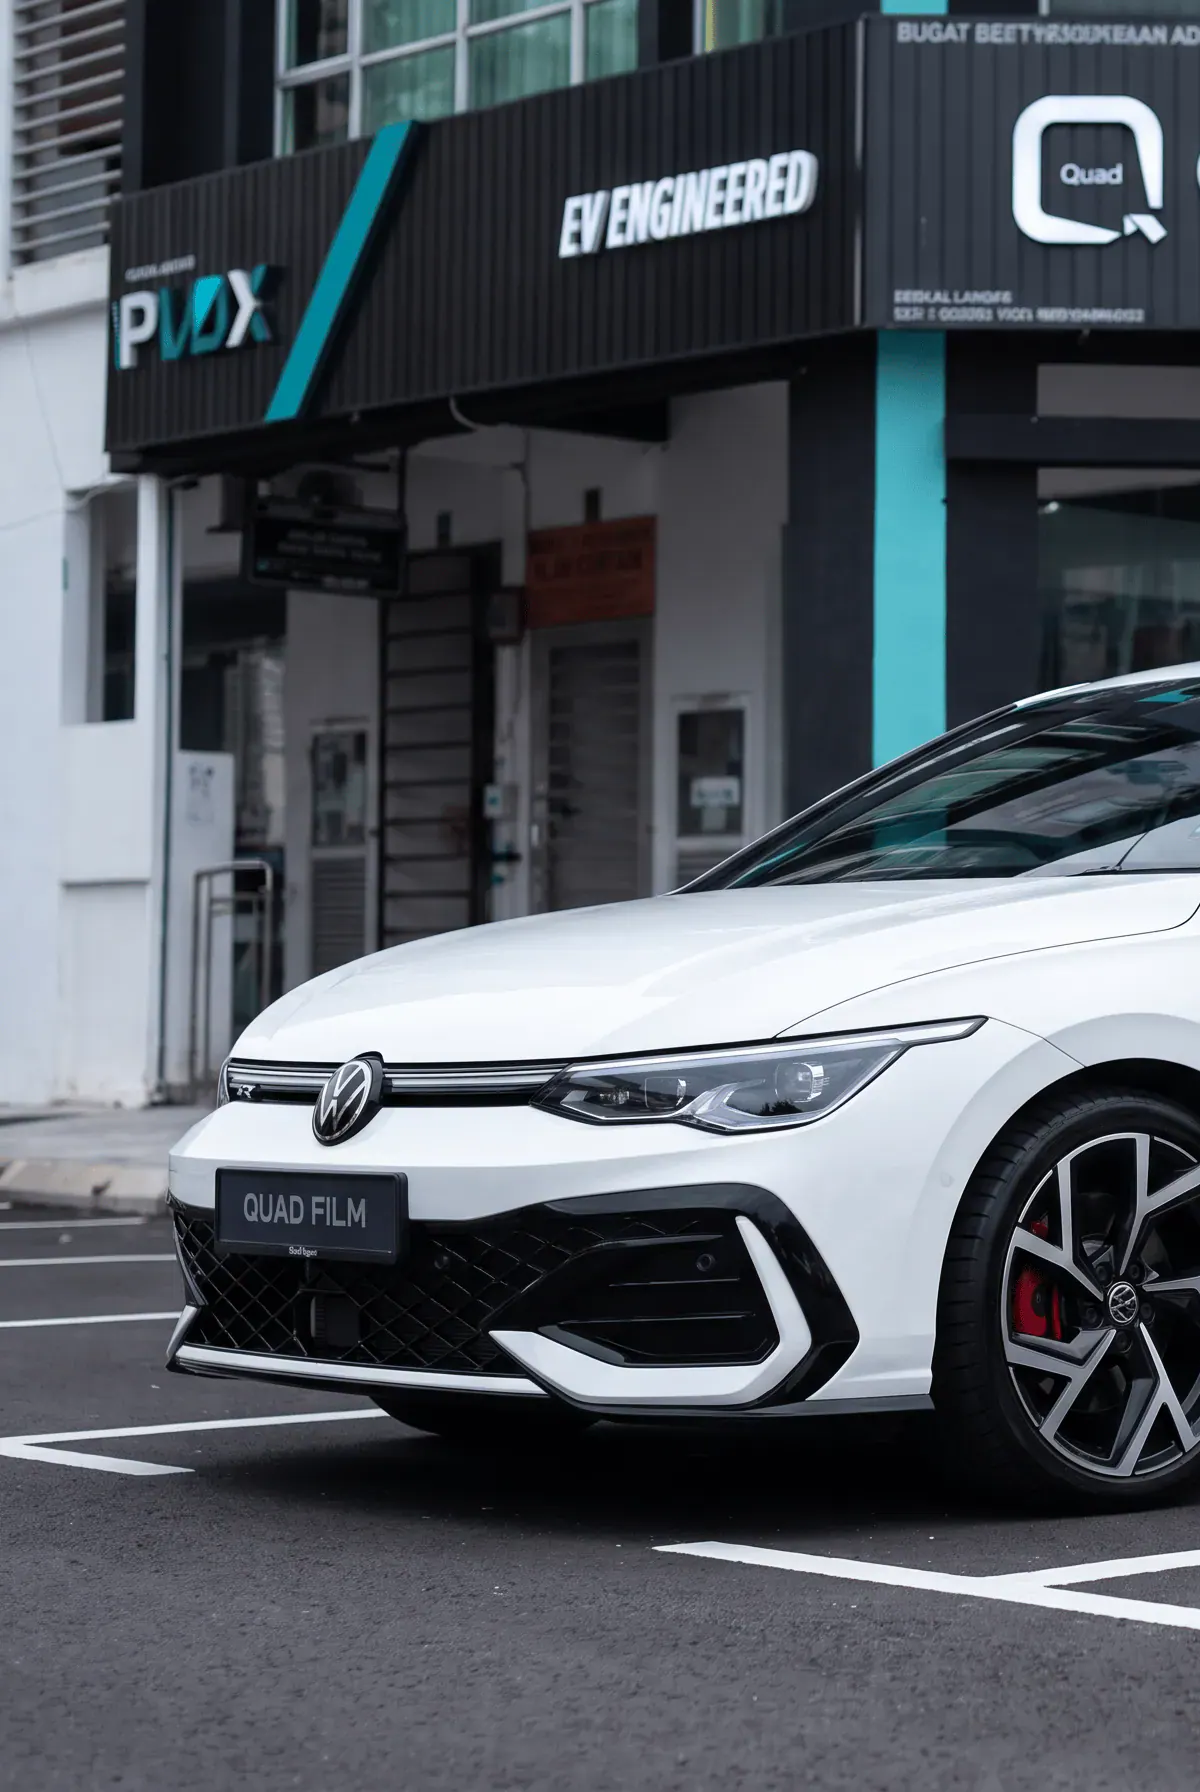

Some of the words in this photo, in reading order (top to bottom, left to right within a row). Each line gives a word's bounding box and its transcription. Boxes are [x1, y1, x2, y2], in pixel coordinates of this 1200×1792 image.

[1060, 163, 1123, 187] Quad
[558, 189, 610, 259] EV
[605, 149, 818, 249] ENGINEERED
[243, 1192, 305, 1225] QUAD
[311, 1196, 366, 1228] FILM
